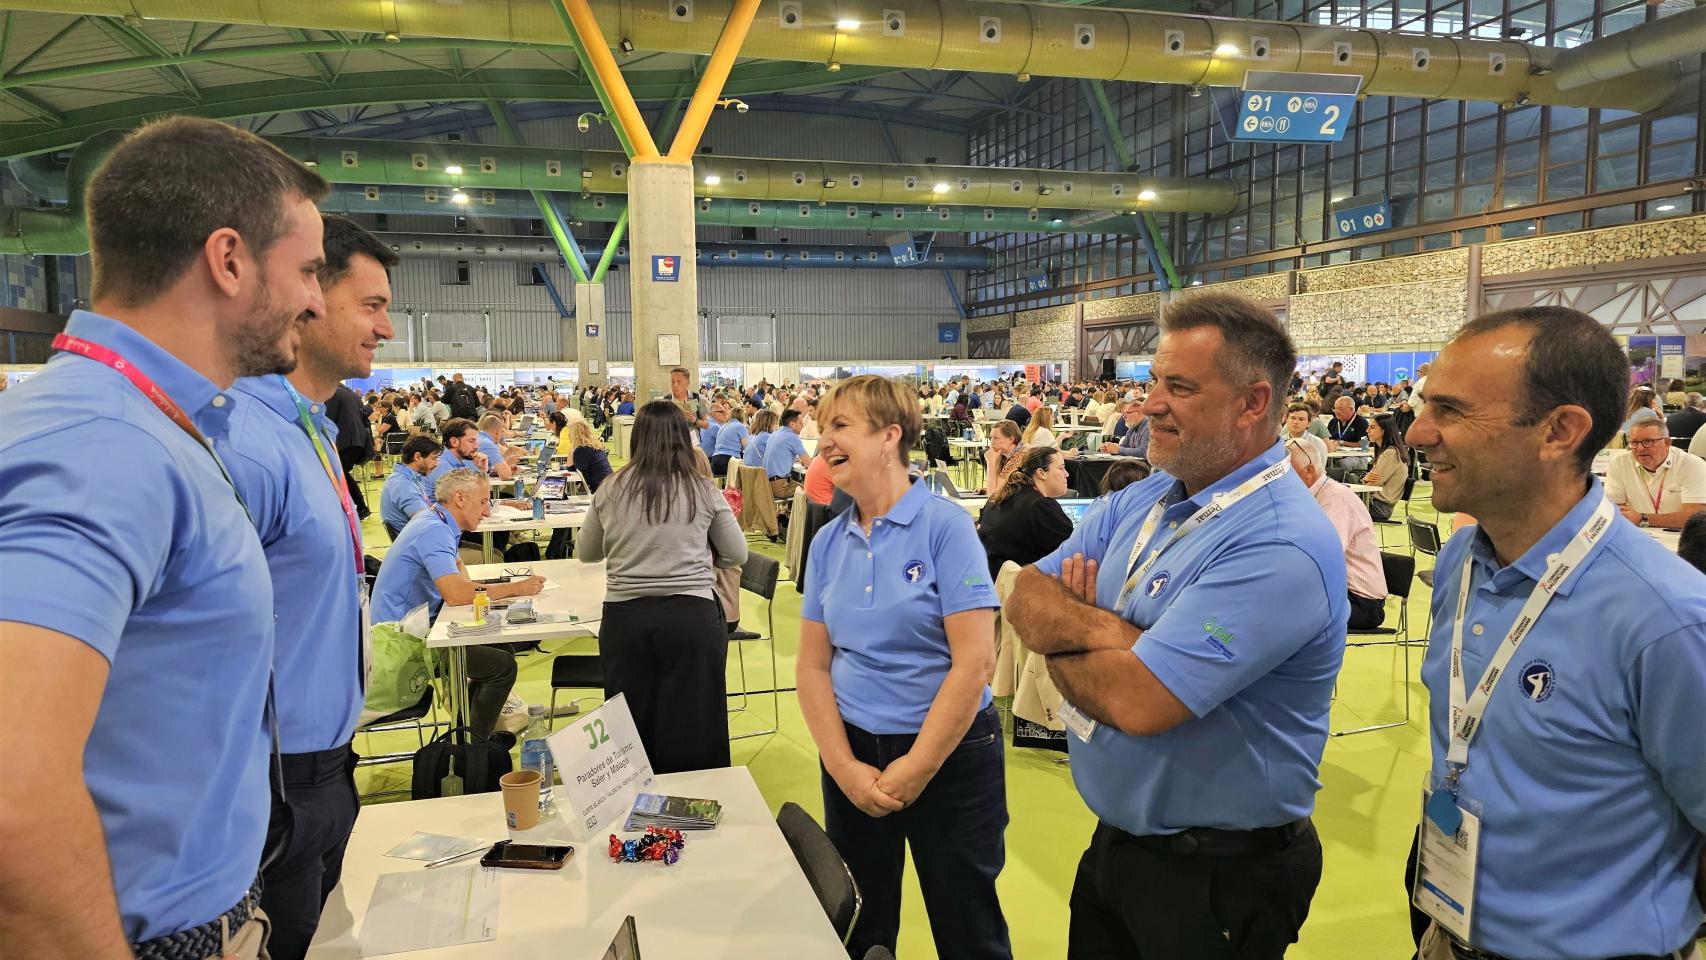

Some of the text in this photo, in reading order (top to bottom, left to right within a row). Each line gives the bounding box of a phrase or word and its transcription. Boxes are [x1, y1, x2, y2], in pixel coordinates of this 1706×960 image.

[1264, 96, 1272, 112] 1
[1319, 105, 1340, 135] 2
[1350, 218, 1357, 230] 1
[1195, 503, 1223, 524] Pemar
[1548, 565, 1570, 590] VALENCIANA
[582, 718, 610, 750] J2
[576, 760, 606, 785] Paradores
[591, 773, 606, 788] Saler
[606, 770, 611, 781] y
